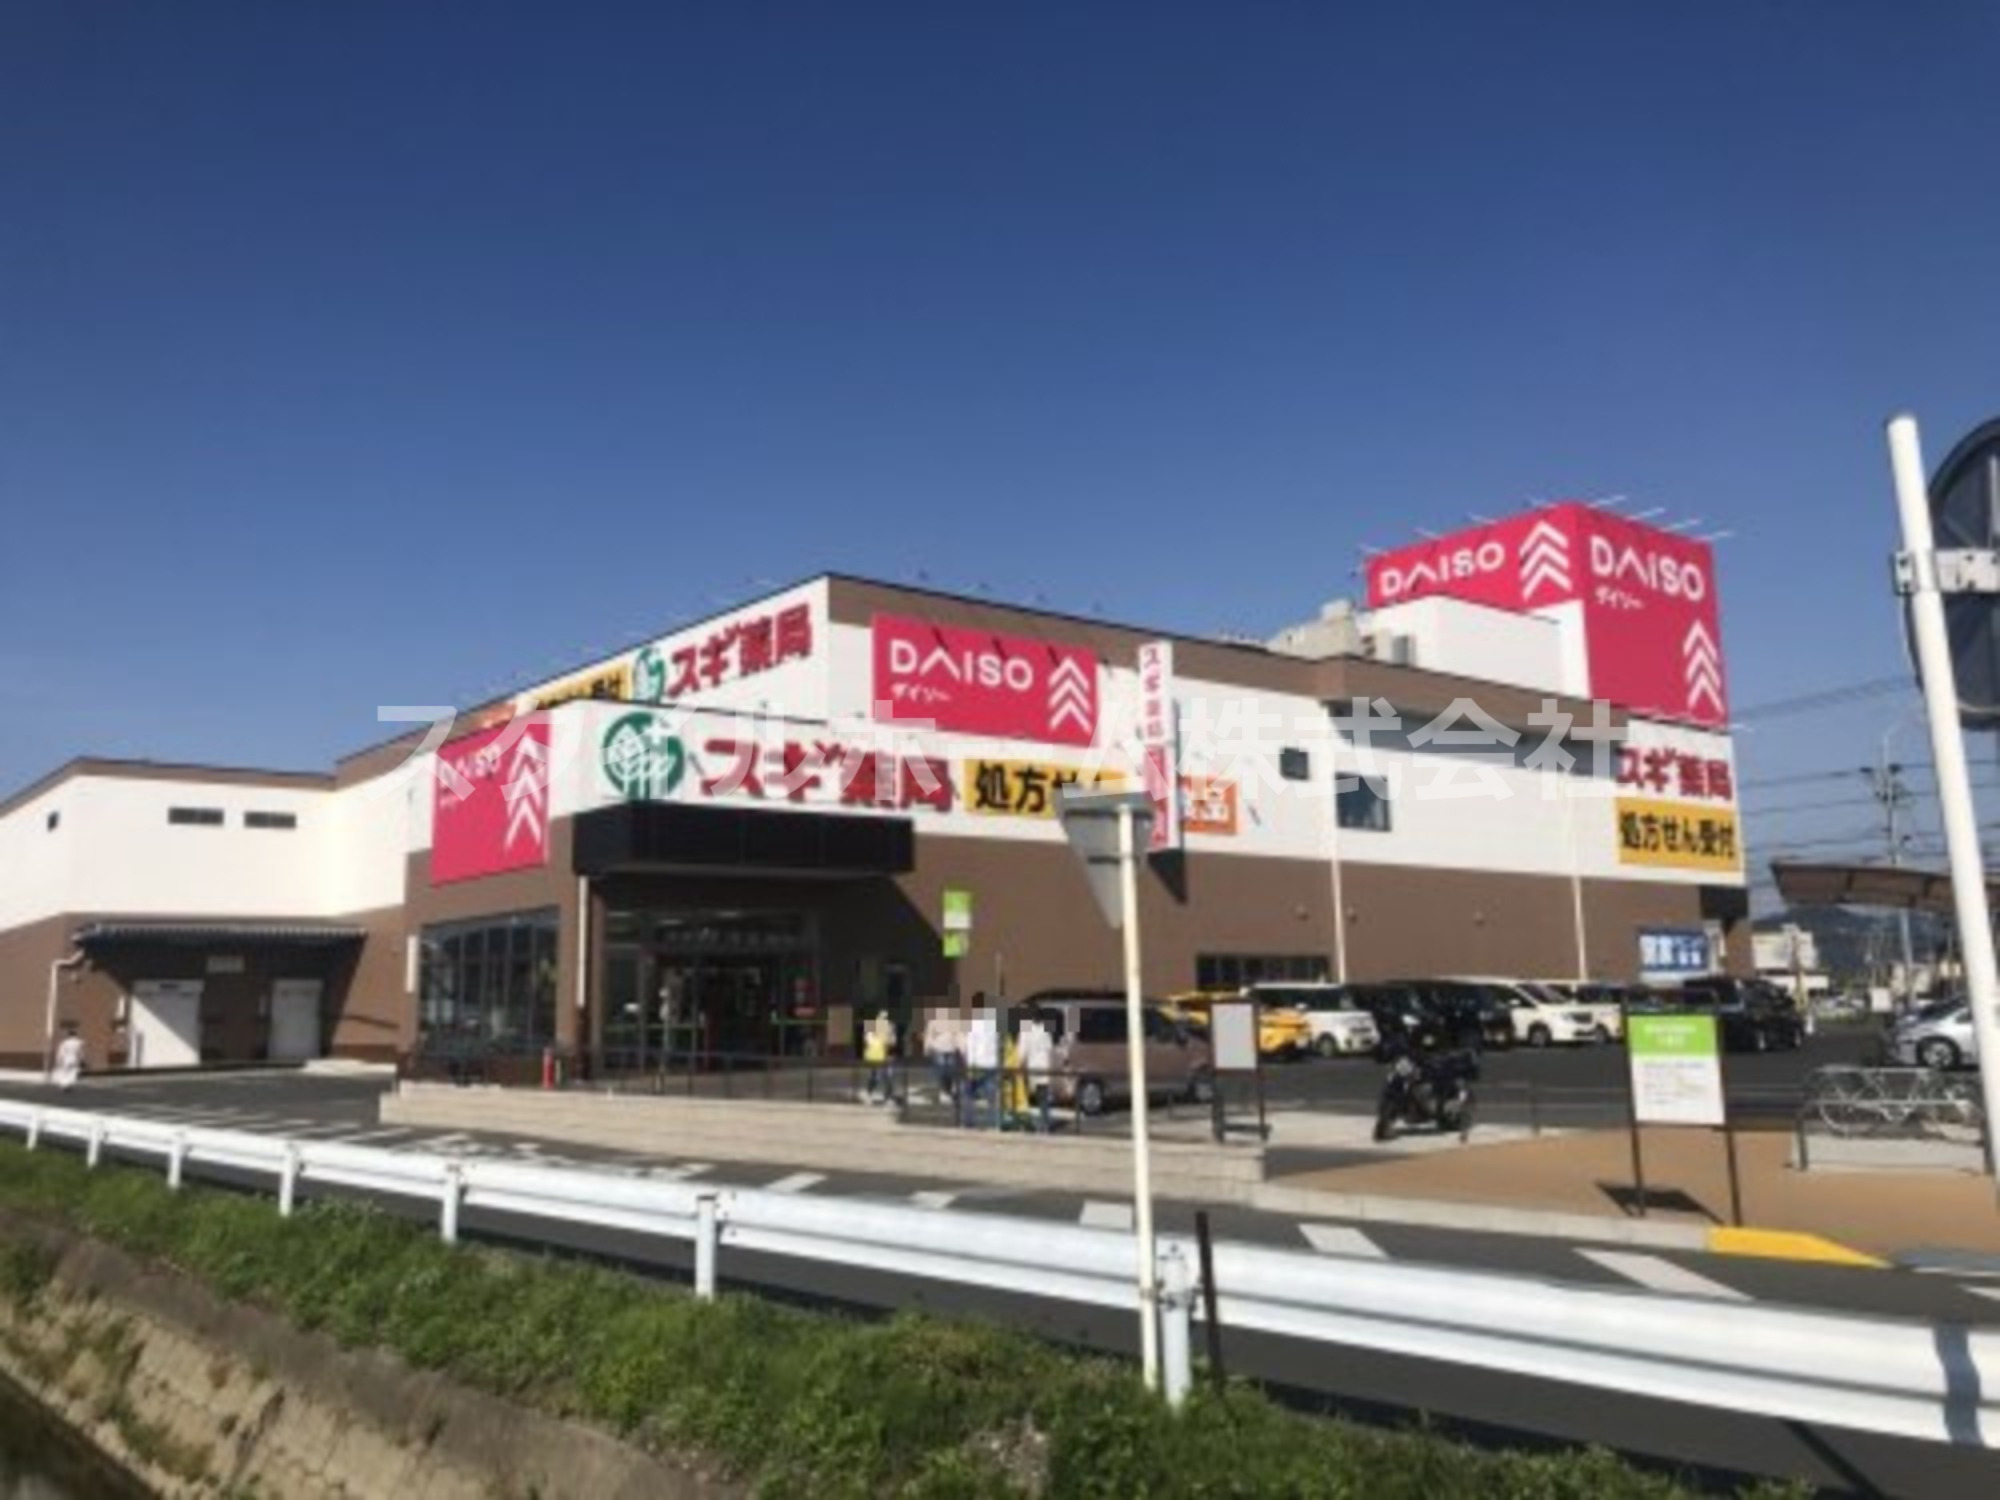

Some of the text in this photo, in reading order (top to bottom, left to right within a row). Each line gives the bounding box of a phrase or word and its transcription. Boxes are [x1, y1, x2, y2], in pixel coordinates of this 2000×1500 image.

[1379, 541, 1505, 598] DAISO
[1590, 535, 1706, 601] DAISO
[668, 602, 813, 698] スギ薬局
[890, 638, 1034, 690] DAISO
[701, 739, 952, 813] スギ薬局
[1615, 746, 1733, 801] スギ薬局
[1620, 812, 1736, 859] 処方せん受付
